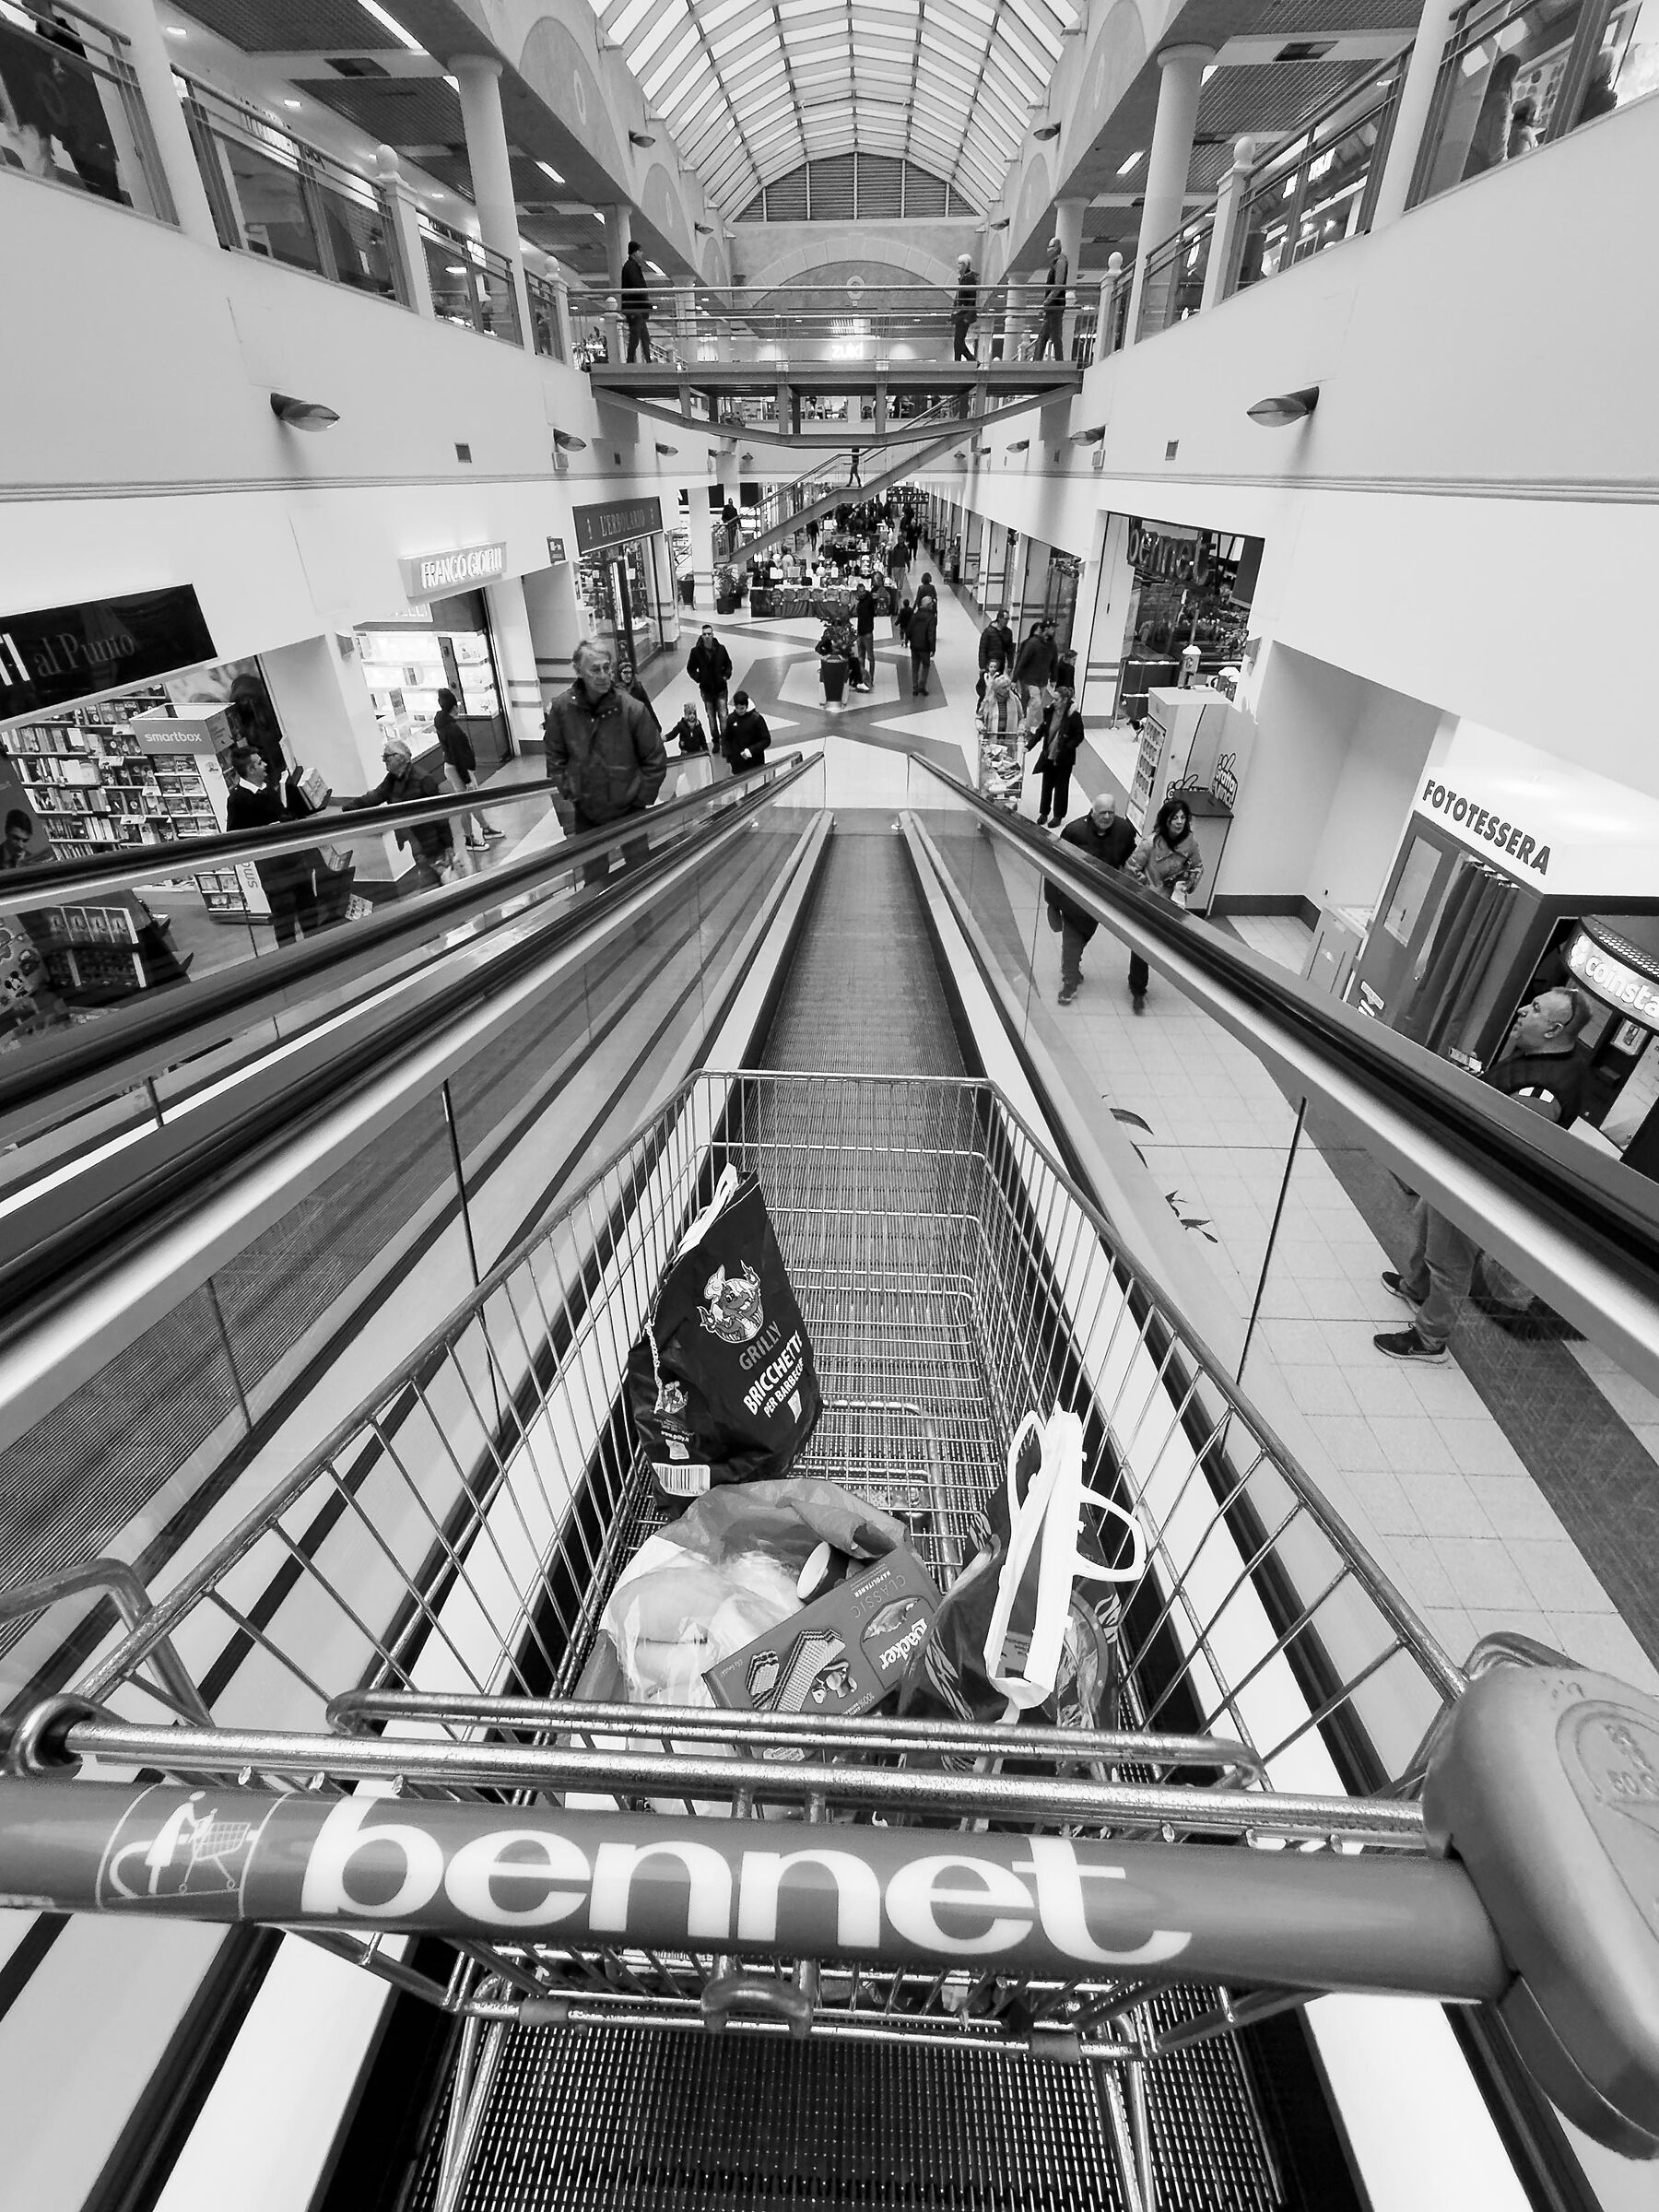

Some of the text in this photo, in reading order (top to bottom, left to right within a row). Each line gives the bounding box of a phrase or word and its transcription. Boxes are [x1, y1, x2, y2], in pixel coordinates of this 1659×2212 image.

[419, 553, 467, 590] FRANCO
[33, 637, 62, 677] al
[55, 633, 136, 671] Punto
[144, 731, 203, 743] smartbox
[1422, 779, 1551, 876] FOTOTESSERA
[739, 1321, 782, 1371] GRILLY
[743, 1329, 803, 1415] BRICCHETTI
[763, 1396, 778, 1418] PER
[850, 1574, 906, 1618] CLASSIC
[300, 1794, 1193, 1967] bennet
